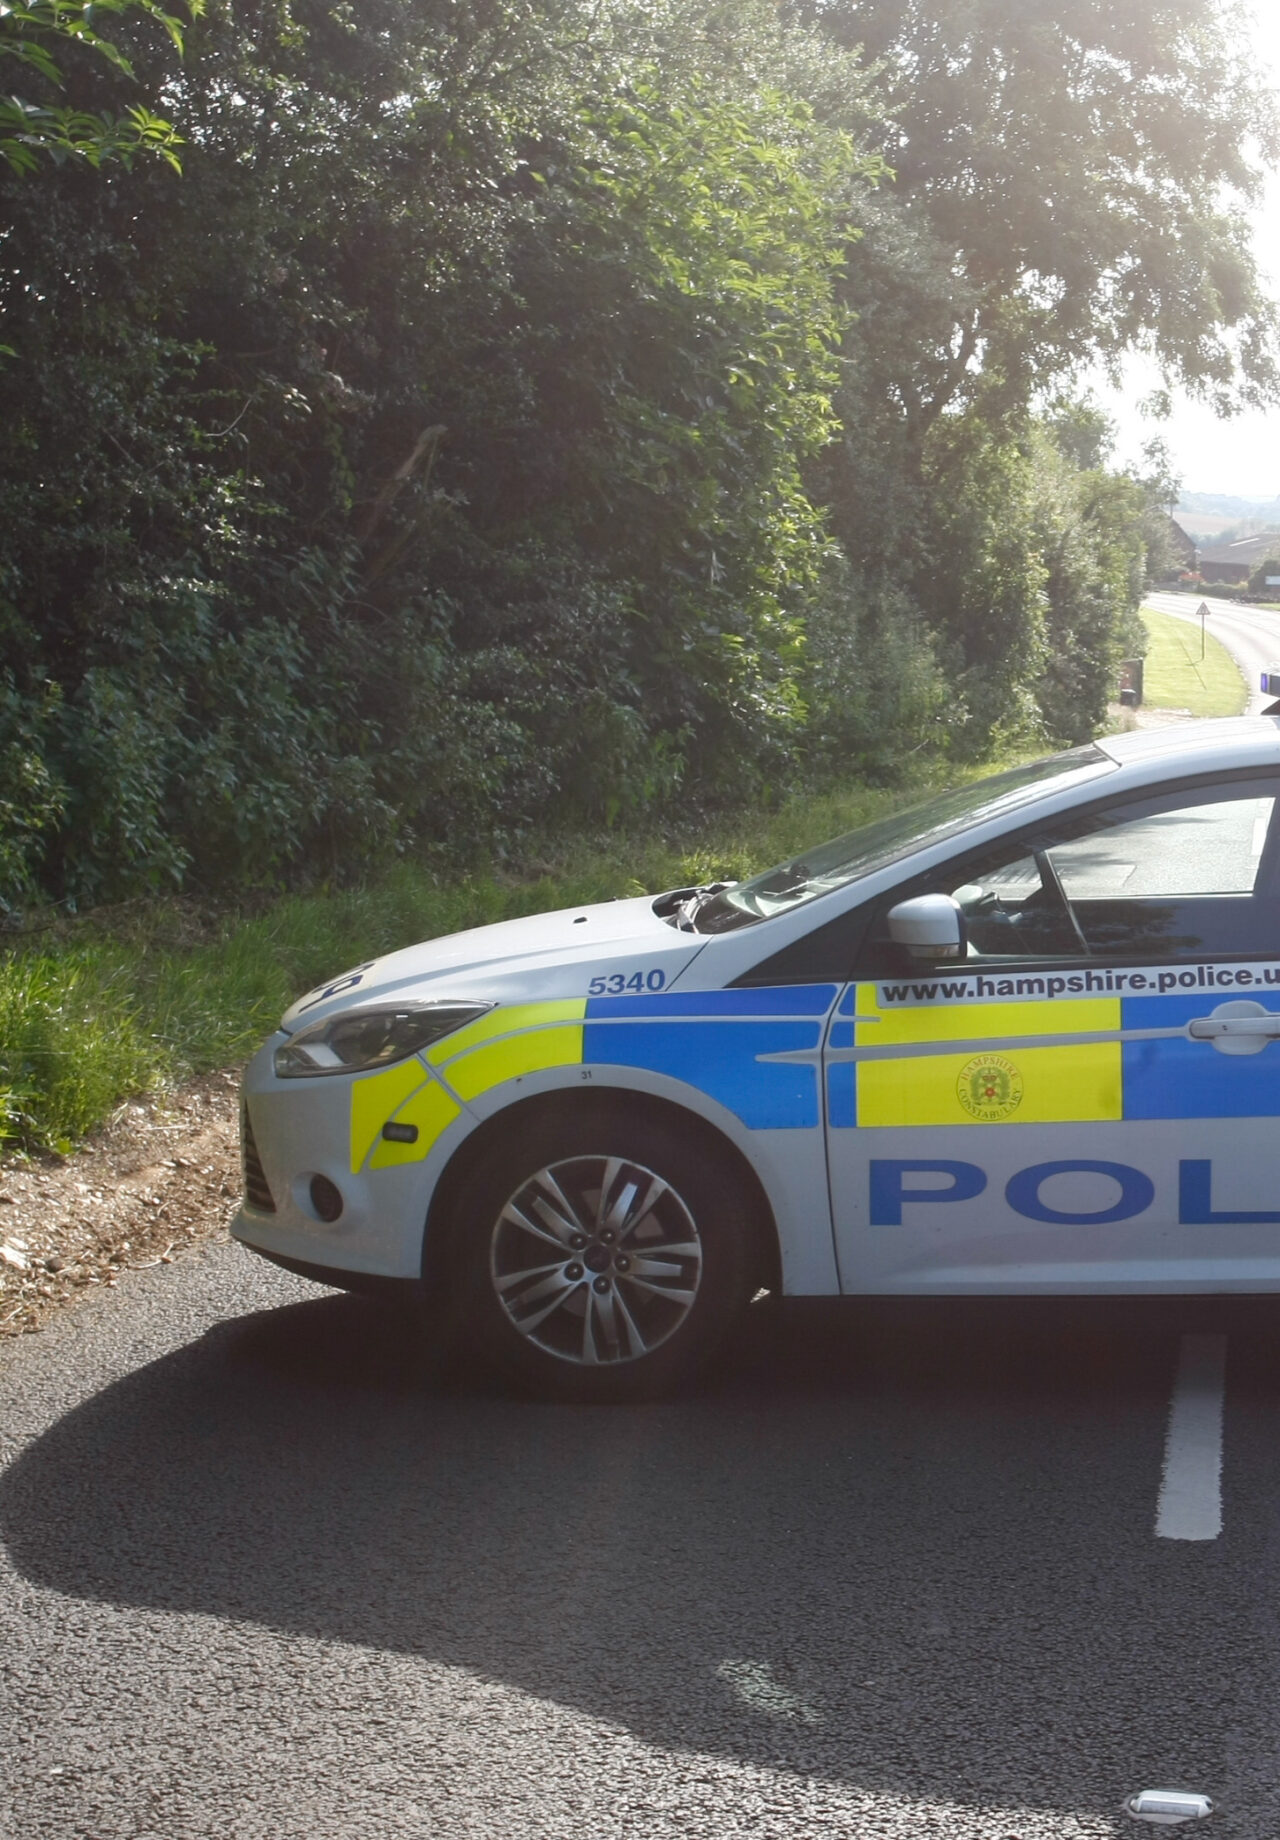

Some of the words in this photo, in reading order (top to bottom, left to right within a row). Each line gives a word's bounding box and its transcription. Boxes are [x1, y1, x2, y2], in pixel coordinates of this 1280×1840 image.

[588, 969, 666, 996] 5340
[961, 1056, 1019, 1080] HAMPSHIRE
[959, 1087, 1021, 1119] CONSTABULARY
